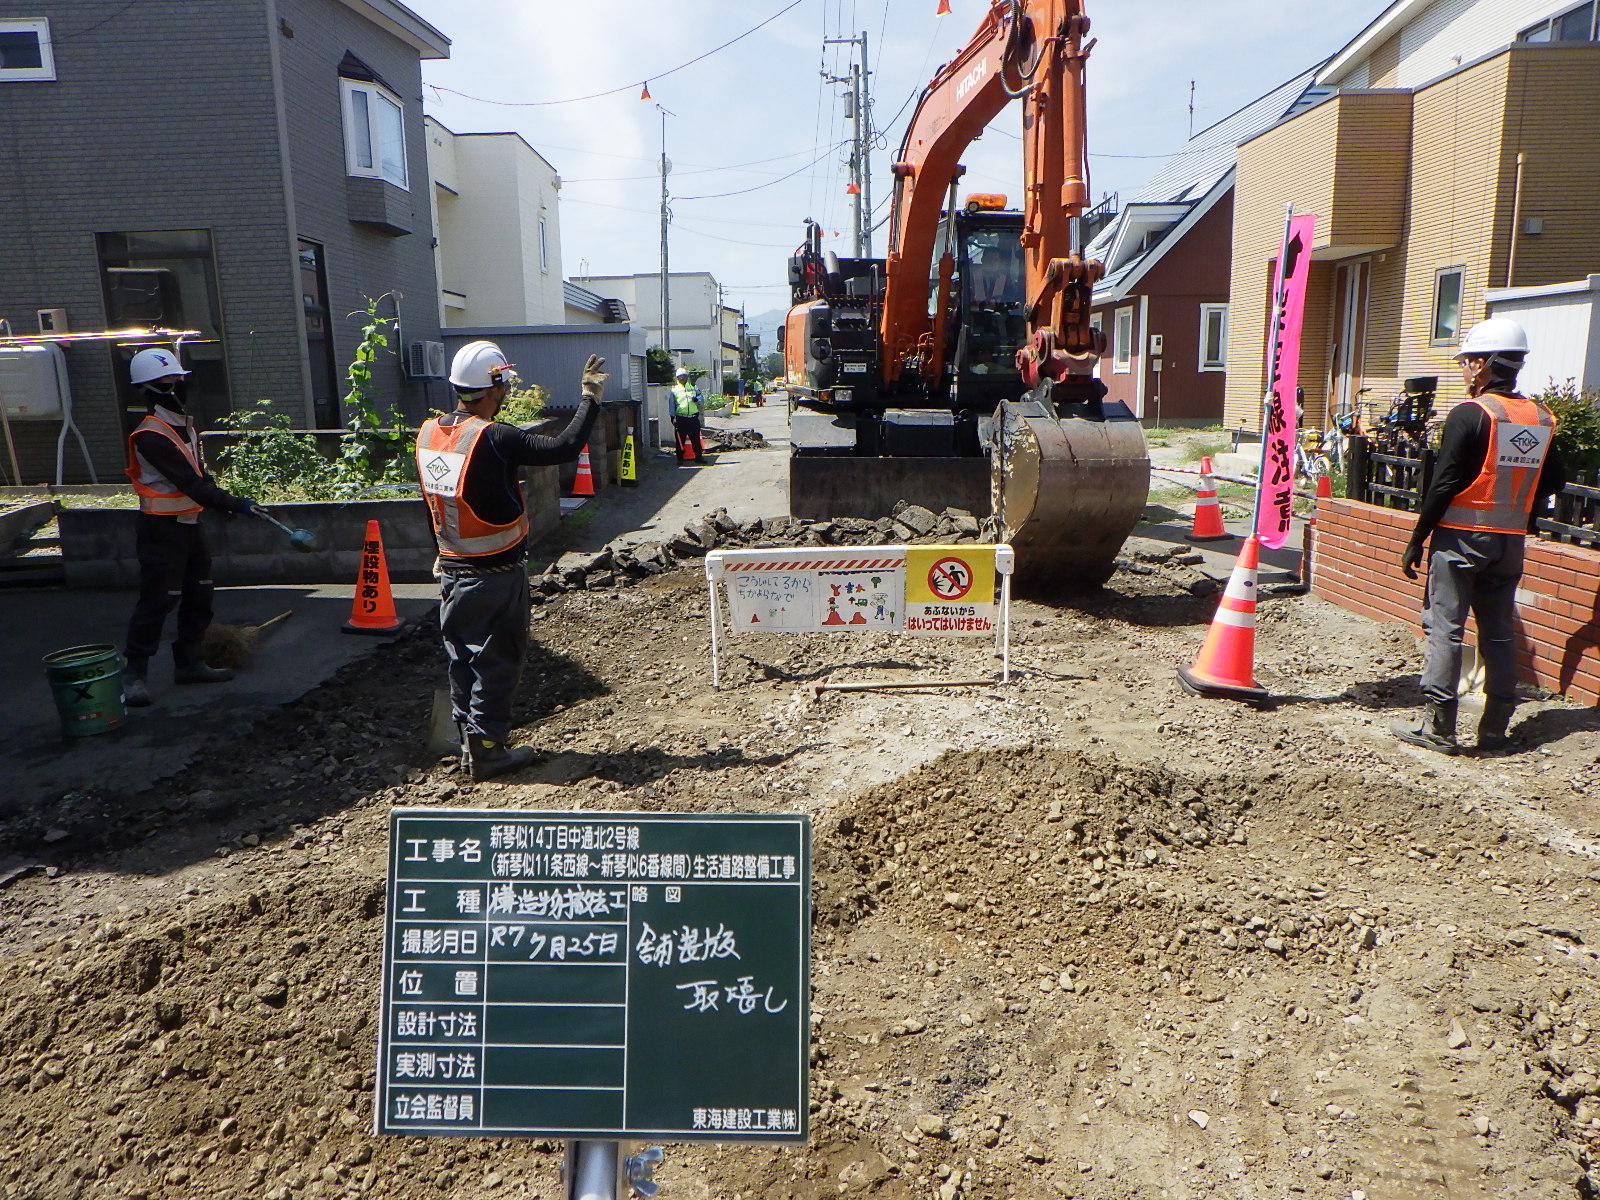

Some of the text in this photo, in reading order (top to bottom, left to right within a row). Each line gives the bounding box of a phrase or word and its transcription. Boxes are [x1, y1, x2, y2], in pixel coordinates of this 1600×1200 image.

[956, 56, 987, 103] HITACHI
[362, 540, 380, 614] 埋設物あり
[908, 617, 992, 632] はいってはいけません
[924, 606, 976, 616] あぶないから
[404, 838, 482, 863] 工事名
[490, 825, 640, 850] 新琴似14丁目中通北2号線
[402, 928, 478, 955] 撮影月日
[676, 976, 788, 1014] 取壊し
[398, 1011, 477, 1037] 設計寸法
[395, 1052, 476, 1079] 実測寸法
[394, 1093, 474, 1121] 立会監督員
